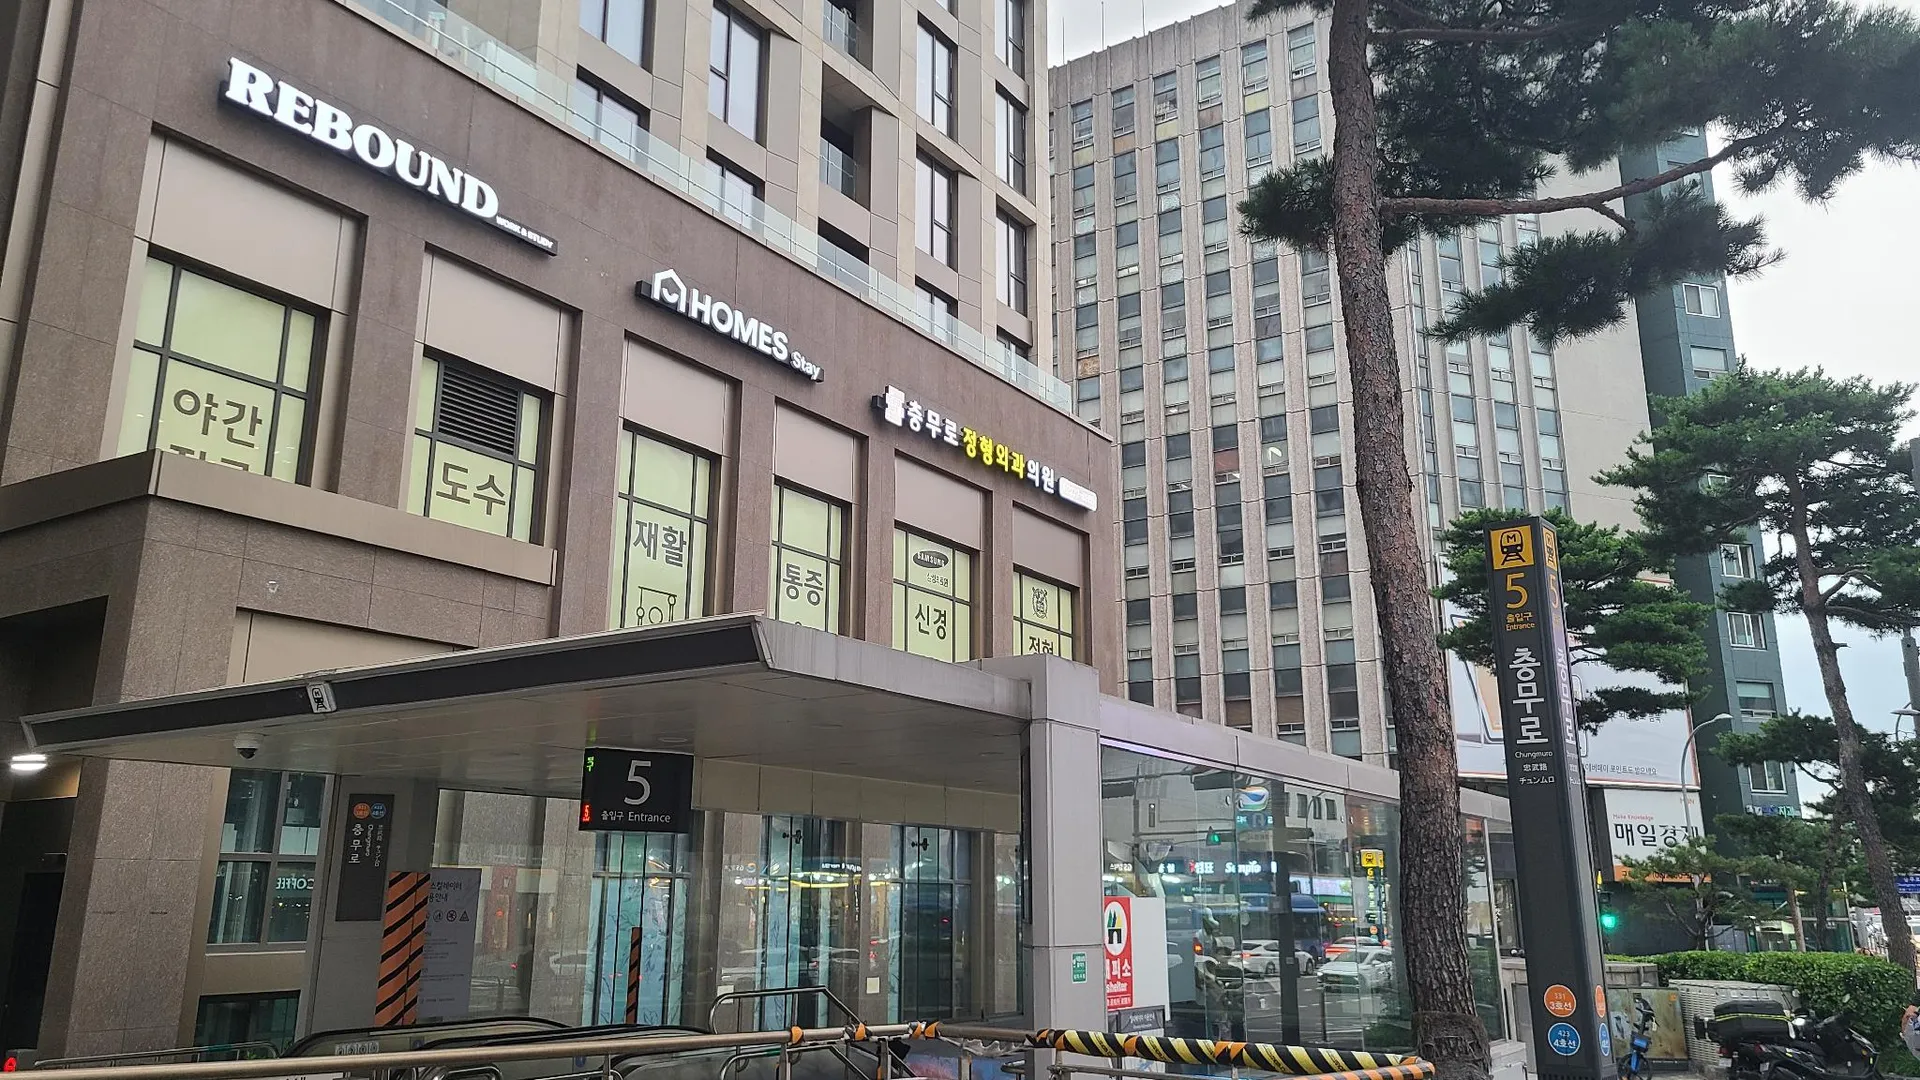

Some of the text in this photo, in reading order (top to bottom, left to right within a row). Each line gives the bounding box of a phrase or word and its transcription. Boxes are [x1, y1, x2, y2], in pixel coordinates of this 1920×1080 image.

[226, 57, 499, 218] REBOUND
[688, 289, 820, 380] HOMES Stay
[174, 389, 262, 448] 야간
[436, 462, 506, 515] 도수
[633, 519, 687, 567] 재활
[782, 563, 824, 606] 통증
[1506, 573, 1528, 609] 5
[915, 604, 947, 640] 신경
[1506, 611, 1533, 623] 출입구
[1506, 622, 1535, 631] Entrance
[1508, 647, 1549, 745] 충무로
[1514, 750, 1553, 759] Chungmuro
[624, 760, 651, 805] 5
[1519, 775, 1555, 785] チュンムロ
[601, 810, 625, 821] 출입구
[628, 811, 671, 823] Entrance
[1549, 1001, 1573, 1011] 3호선
[1553, 1038, 1577, 1049] 4호선
